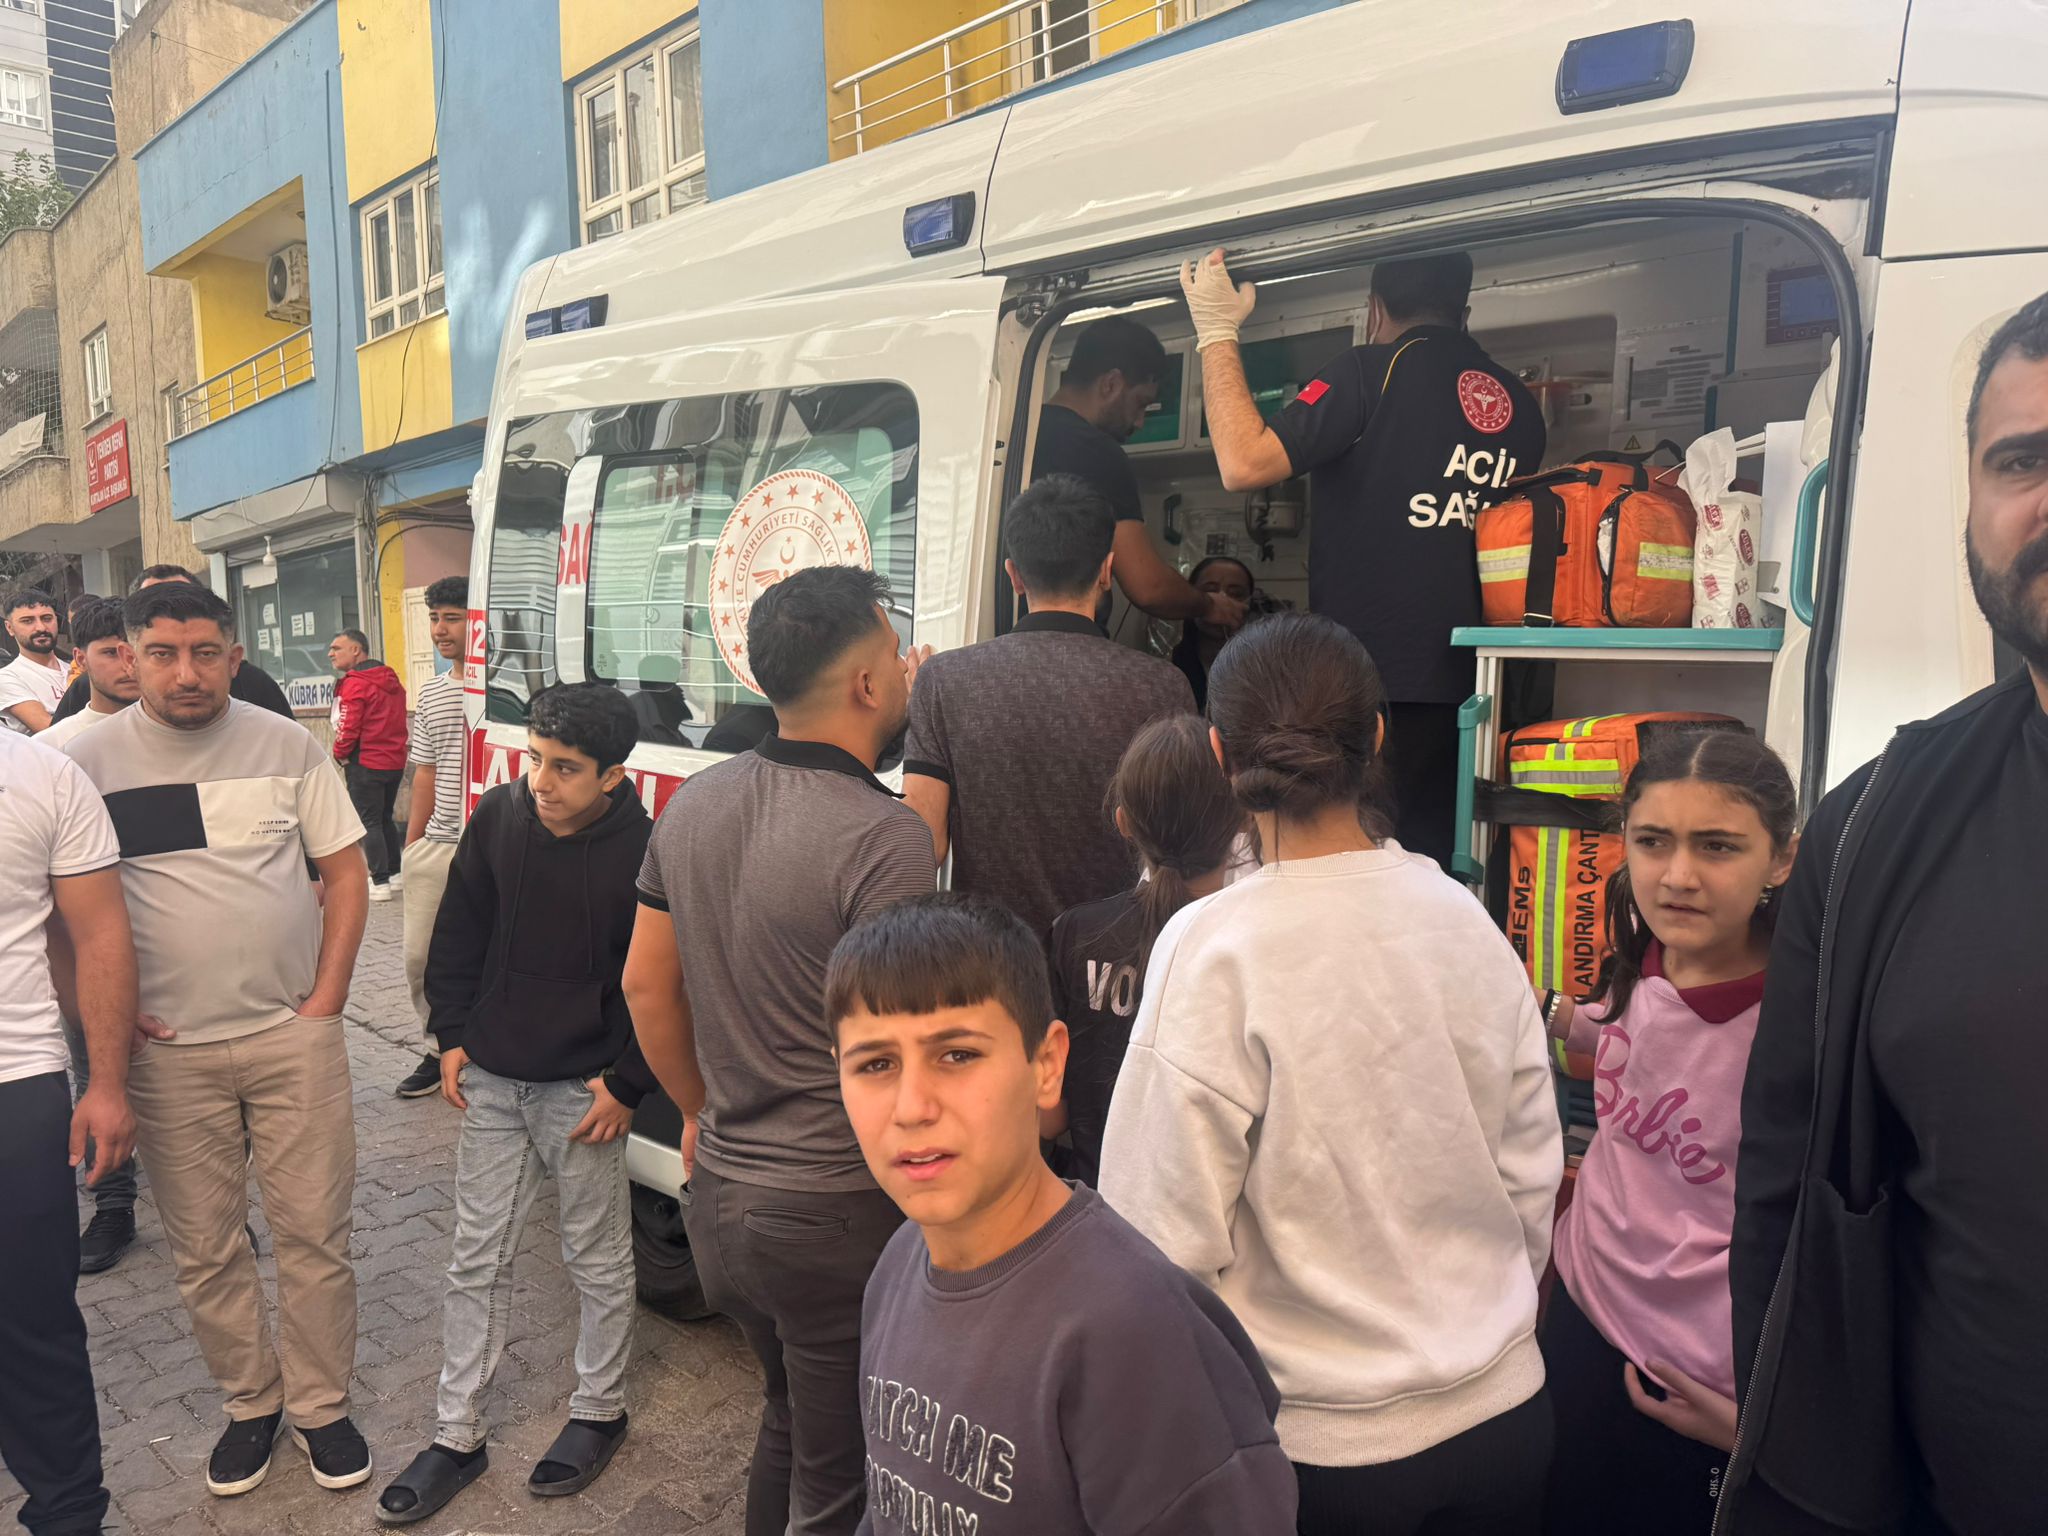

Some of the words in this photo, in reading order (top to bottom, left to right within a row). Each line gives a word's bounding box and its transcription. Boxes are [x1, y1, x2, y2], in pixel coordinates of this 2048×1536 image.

[737, 510, 799, 582] CUMHURİYETİ
[802, 515, 836, 557] SAĞLIK
[288, 681, 318, 706] KÜBRA
[943, 1414, 1016, 1503] ME
